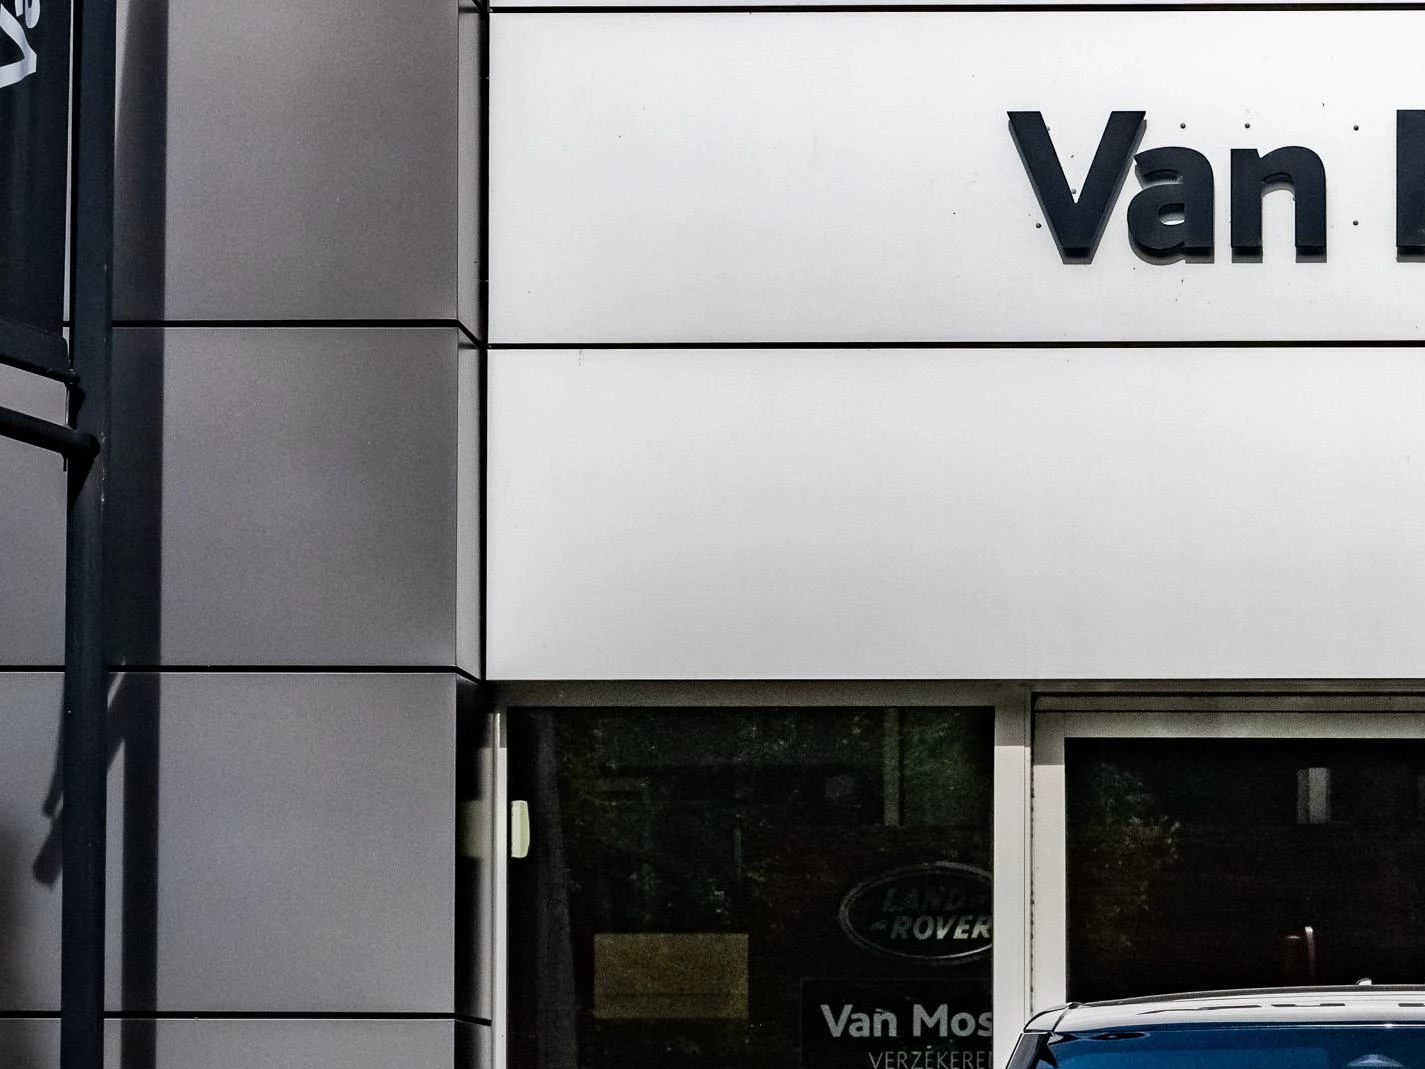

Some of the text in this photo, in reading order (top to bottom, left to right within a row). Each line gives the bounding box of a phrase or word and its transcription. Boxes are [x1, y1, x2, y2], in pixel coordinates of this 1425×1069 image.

[1006, 109, 1328, 262] Van
[889, 915, 992, 940] ROVER
[820, 1003, 993, 1038] Van Mos
